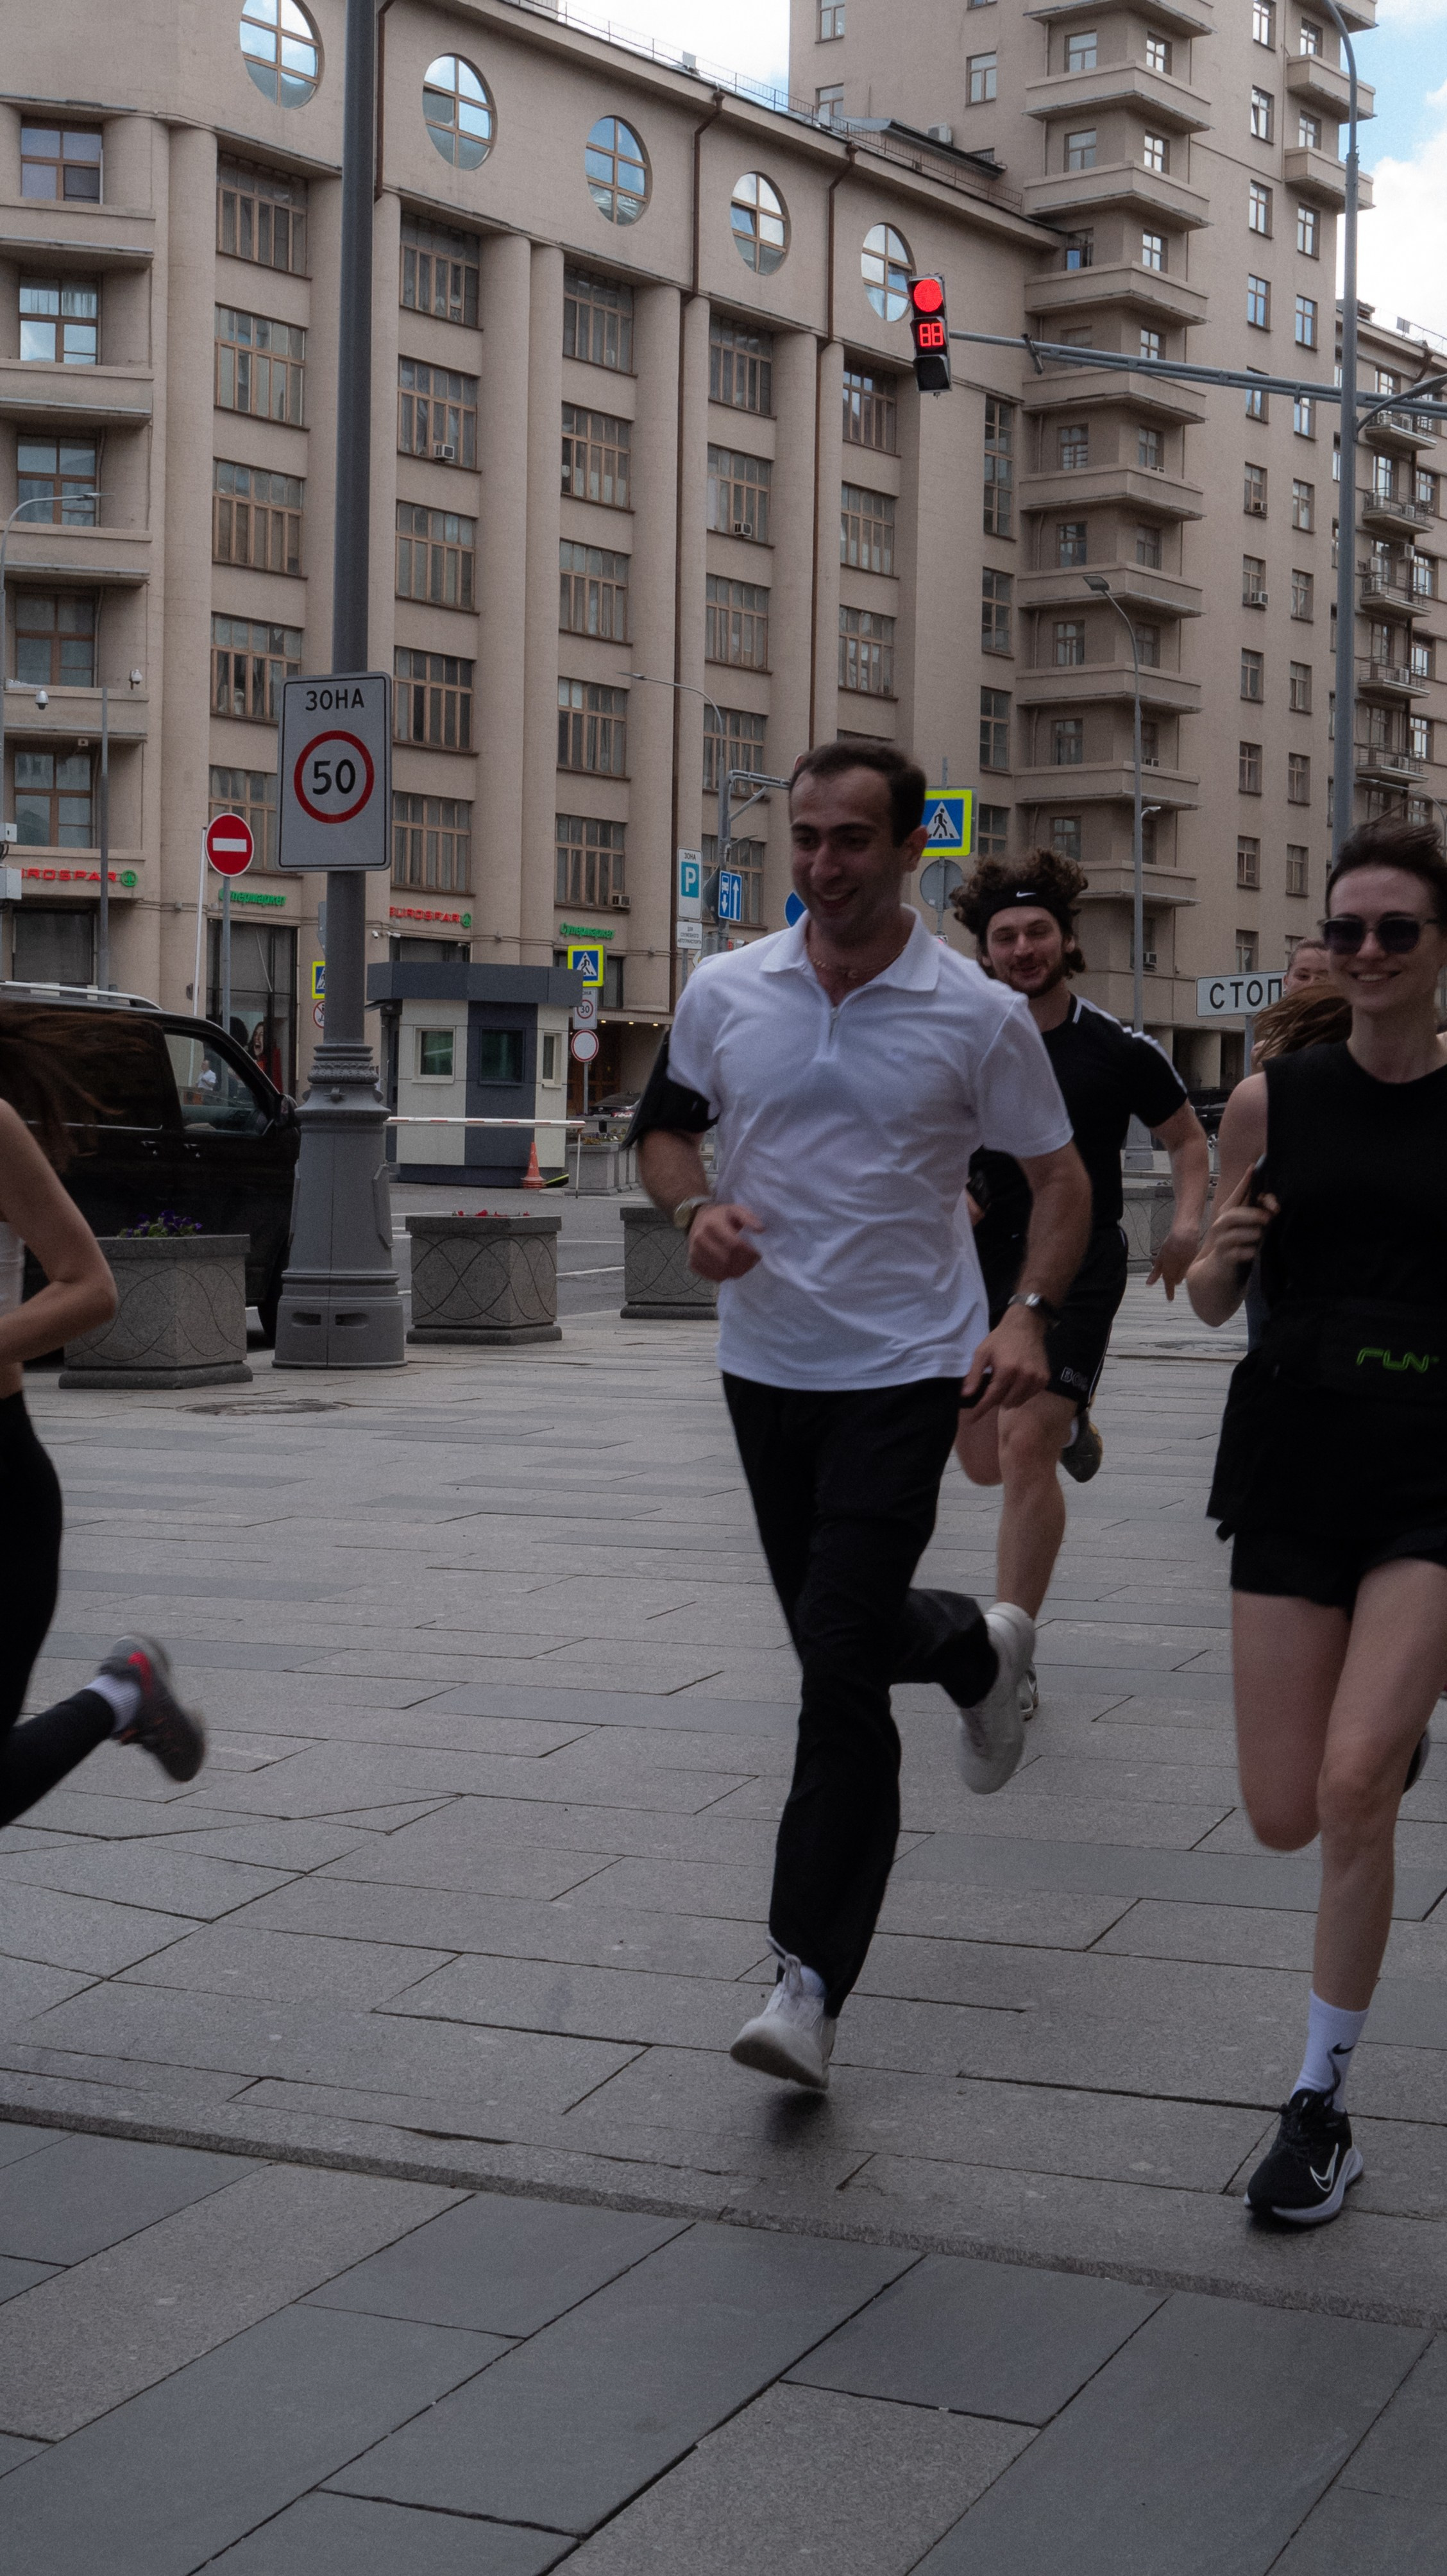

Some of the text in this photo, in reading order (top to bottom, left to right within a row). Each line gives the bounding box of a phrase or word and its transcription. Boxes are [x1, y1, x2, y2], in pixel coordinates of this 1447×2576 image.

[919, 322, 944, 347] 88
[305, 688, 364, 711] ЗОНА
[312, 759, 356, 795] 50
[21, 868, 116, 882] ROSPAR
[219, 888, 286, 906] Спермаркет
[389, 906, 460, 922] EUROSPAR
[1209, 978, 1283, 1009] СТОП
[580, 1005, 590, 1013] 30
